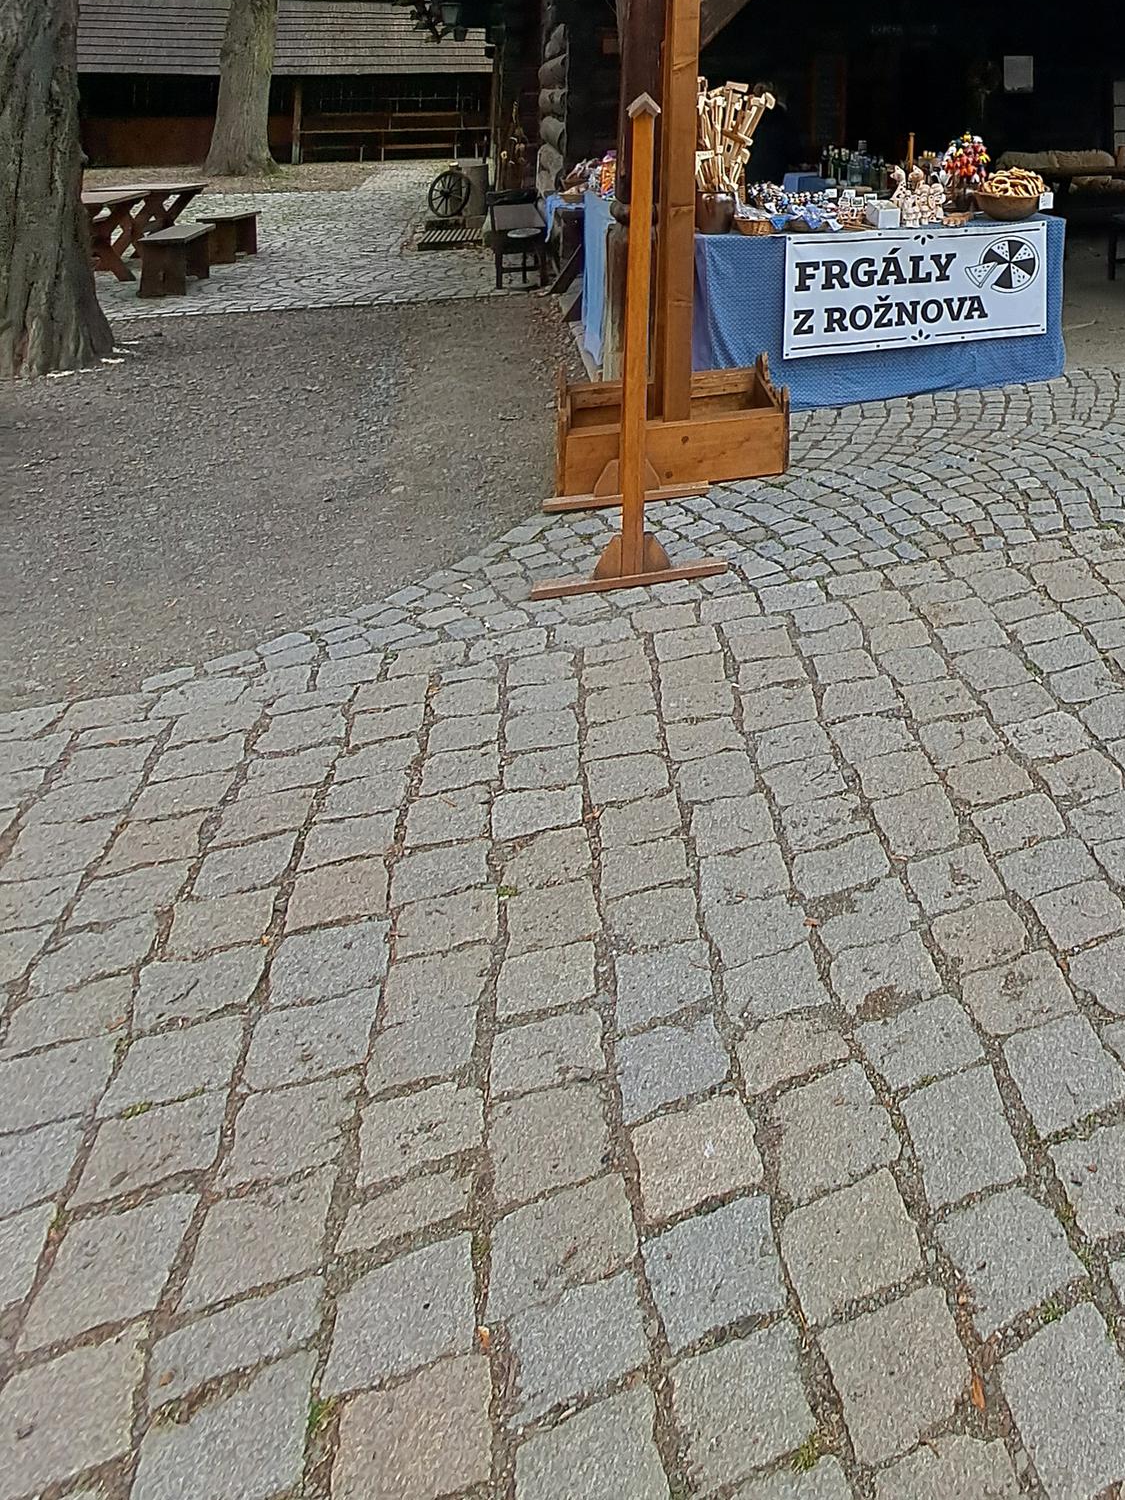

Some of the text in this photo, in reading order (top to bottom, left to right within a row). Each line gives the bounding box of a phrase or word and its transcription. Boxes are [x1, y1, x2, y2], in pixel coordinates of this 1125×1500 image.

[794, 247, 957, 292] FRGÁLY
[793, 295, 988, 336] Z ROŽNOVA
